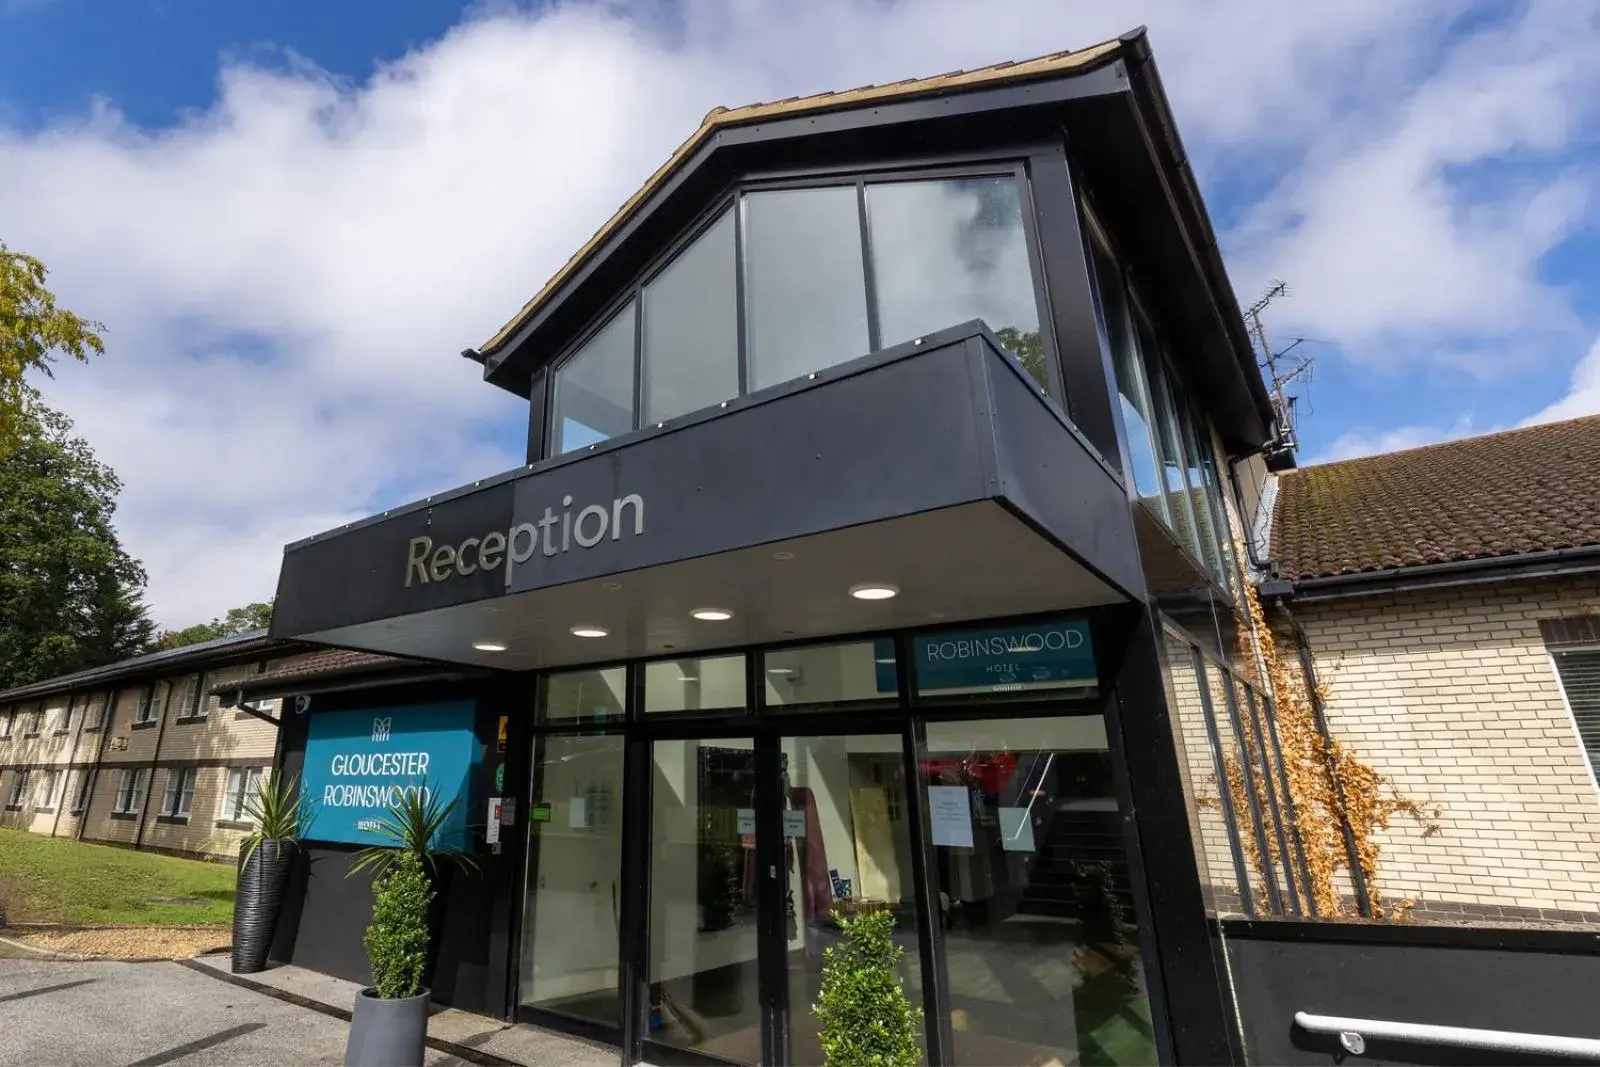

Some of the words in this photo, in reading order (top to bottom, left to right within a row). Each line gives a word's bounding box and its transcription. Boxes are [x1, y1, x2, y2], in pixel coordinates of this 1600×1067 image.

[404, 494, 644, 588] Reception
[927, 629, 1084, 662] ROBINSWOOD
[986, 663, 1021, 673] HOTEL
[331, 752, 430, 776] GLOUCESTER
